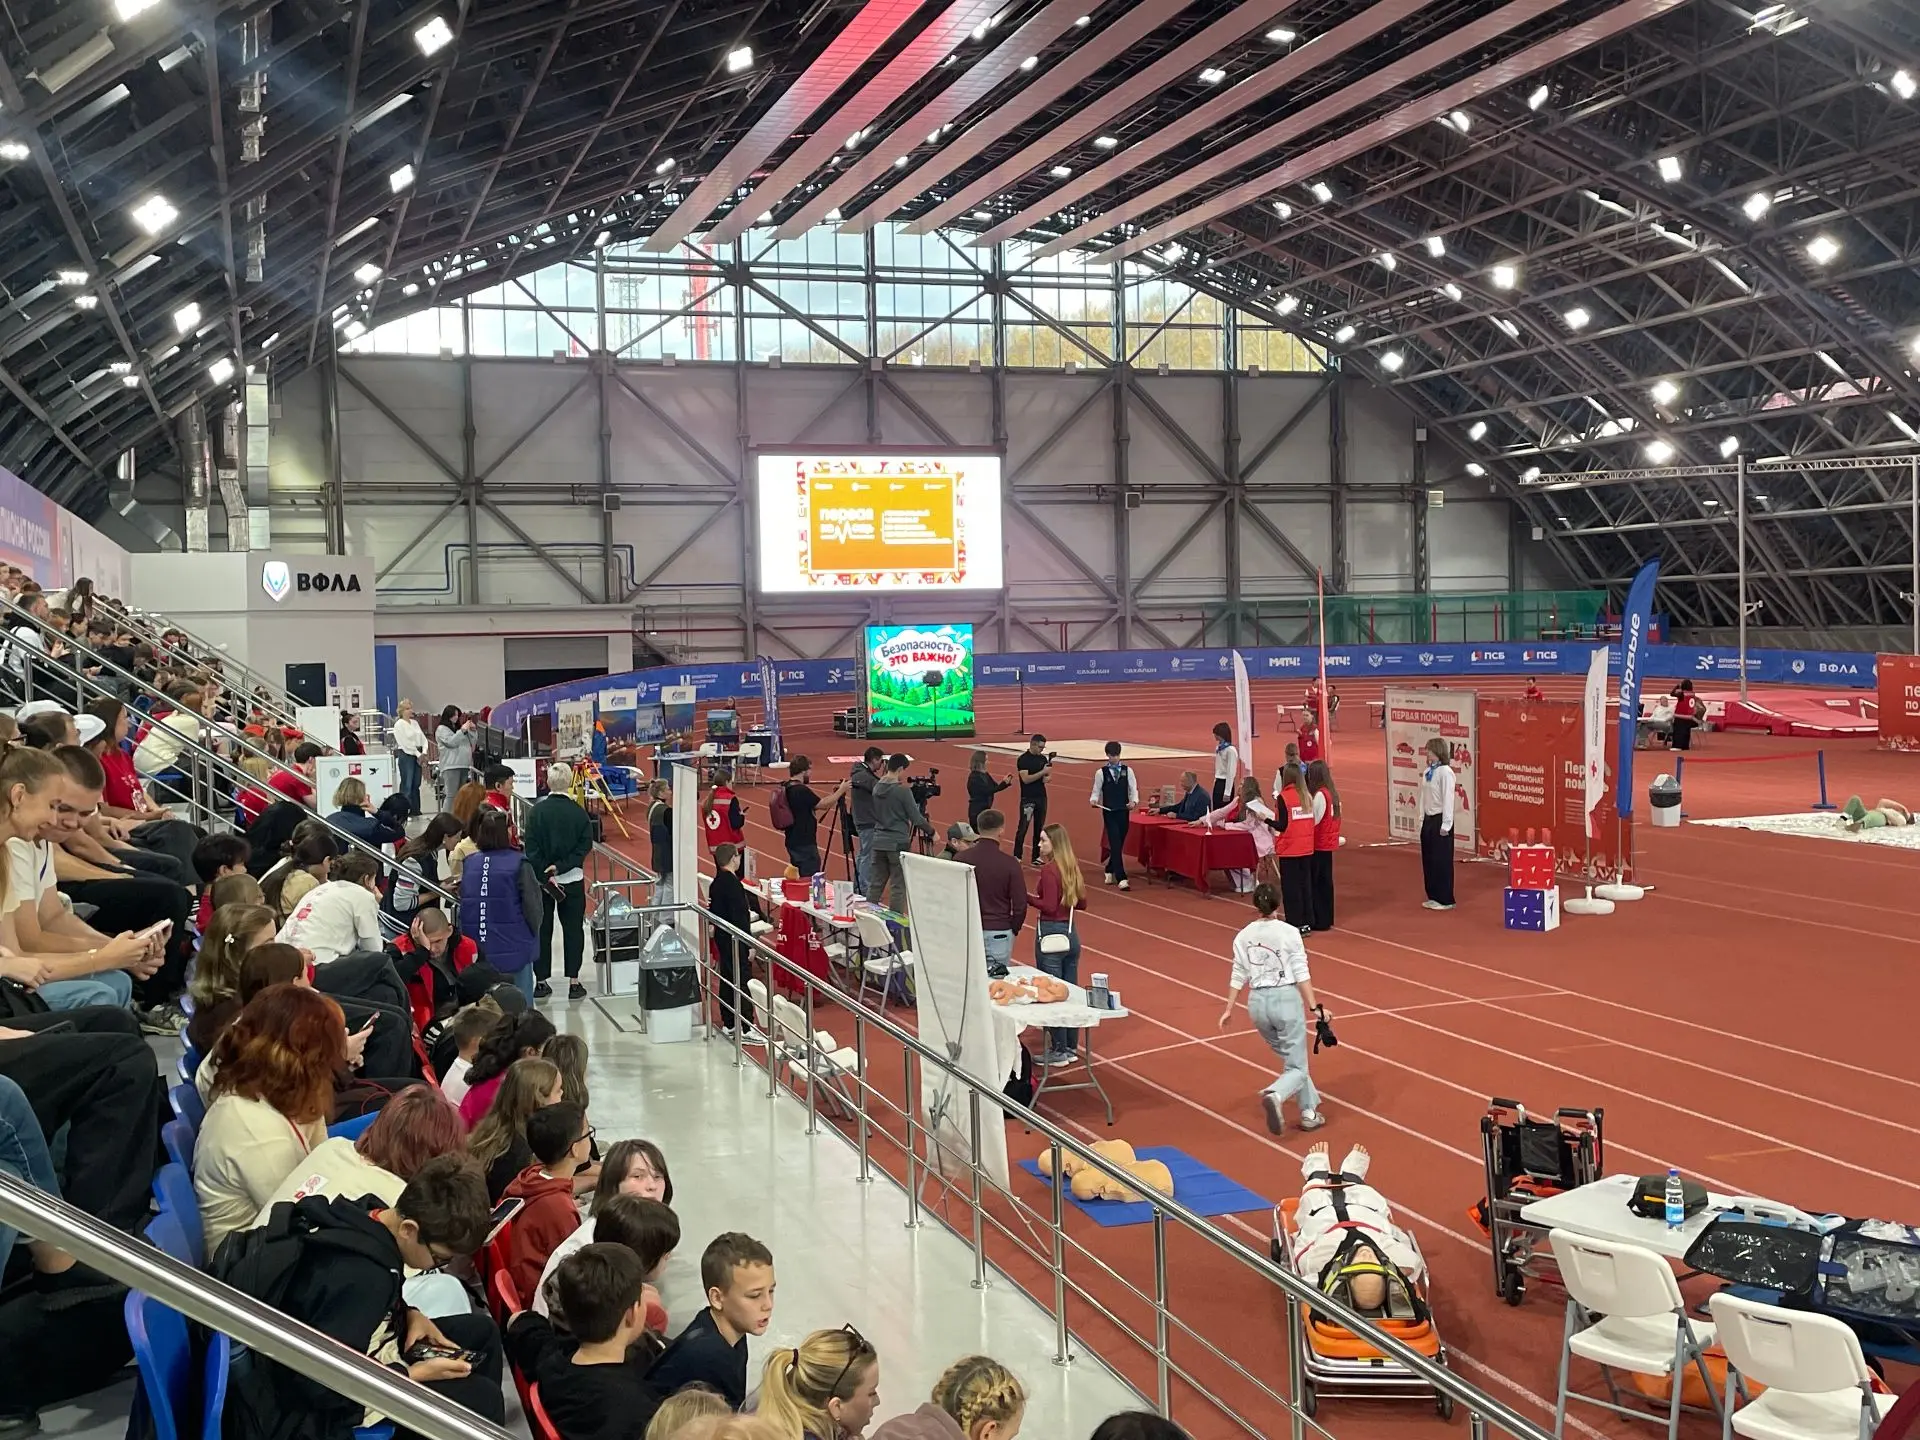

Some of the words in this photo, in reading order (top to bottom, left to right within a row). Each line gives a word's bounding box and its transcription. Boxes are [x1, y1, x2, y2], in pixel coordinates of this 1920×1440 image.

[297, 573, 361, 591] ВФЛА
[880, 641, 954, 658] Безопасность
[1484, 651, 1505, 660] ПСБ
[1536, 650, 1558, 660] ПСБ
[912, 651, 957, 665] ВАЖНО!
[1269, 656, 1300, 667] МАТЧ!
[1819, 662, 1858, 675] ВФЛА
[788, 671, 805, 680] ПСБ
[1392, 709, 1420, 721] ПЕРВАЯ
[1493, 761, 1545, 774] РЕГИОНАЛЬНЫЙ
[1506, 774, 1545, 784] ЧЕМПИОНАТ
[1498, 782, 1508, 790] ПО
[1508, 784, 1545, 795] ОКАЗАНИЮ
[1489, 790, 1514, 801] ПЕРВОЙ
[1513, 793, 1545, 805] ПОМОЩИ
[481, 856, 490, 896] ПОХОДЫ
[479, 902, 487, 942] ПЕРВЫХ
